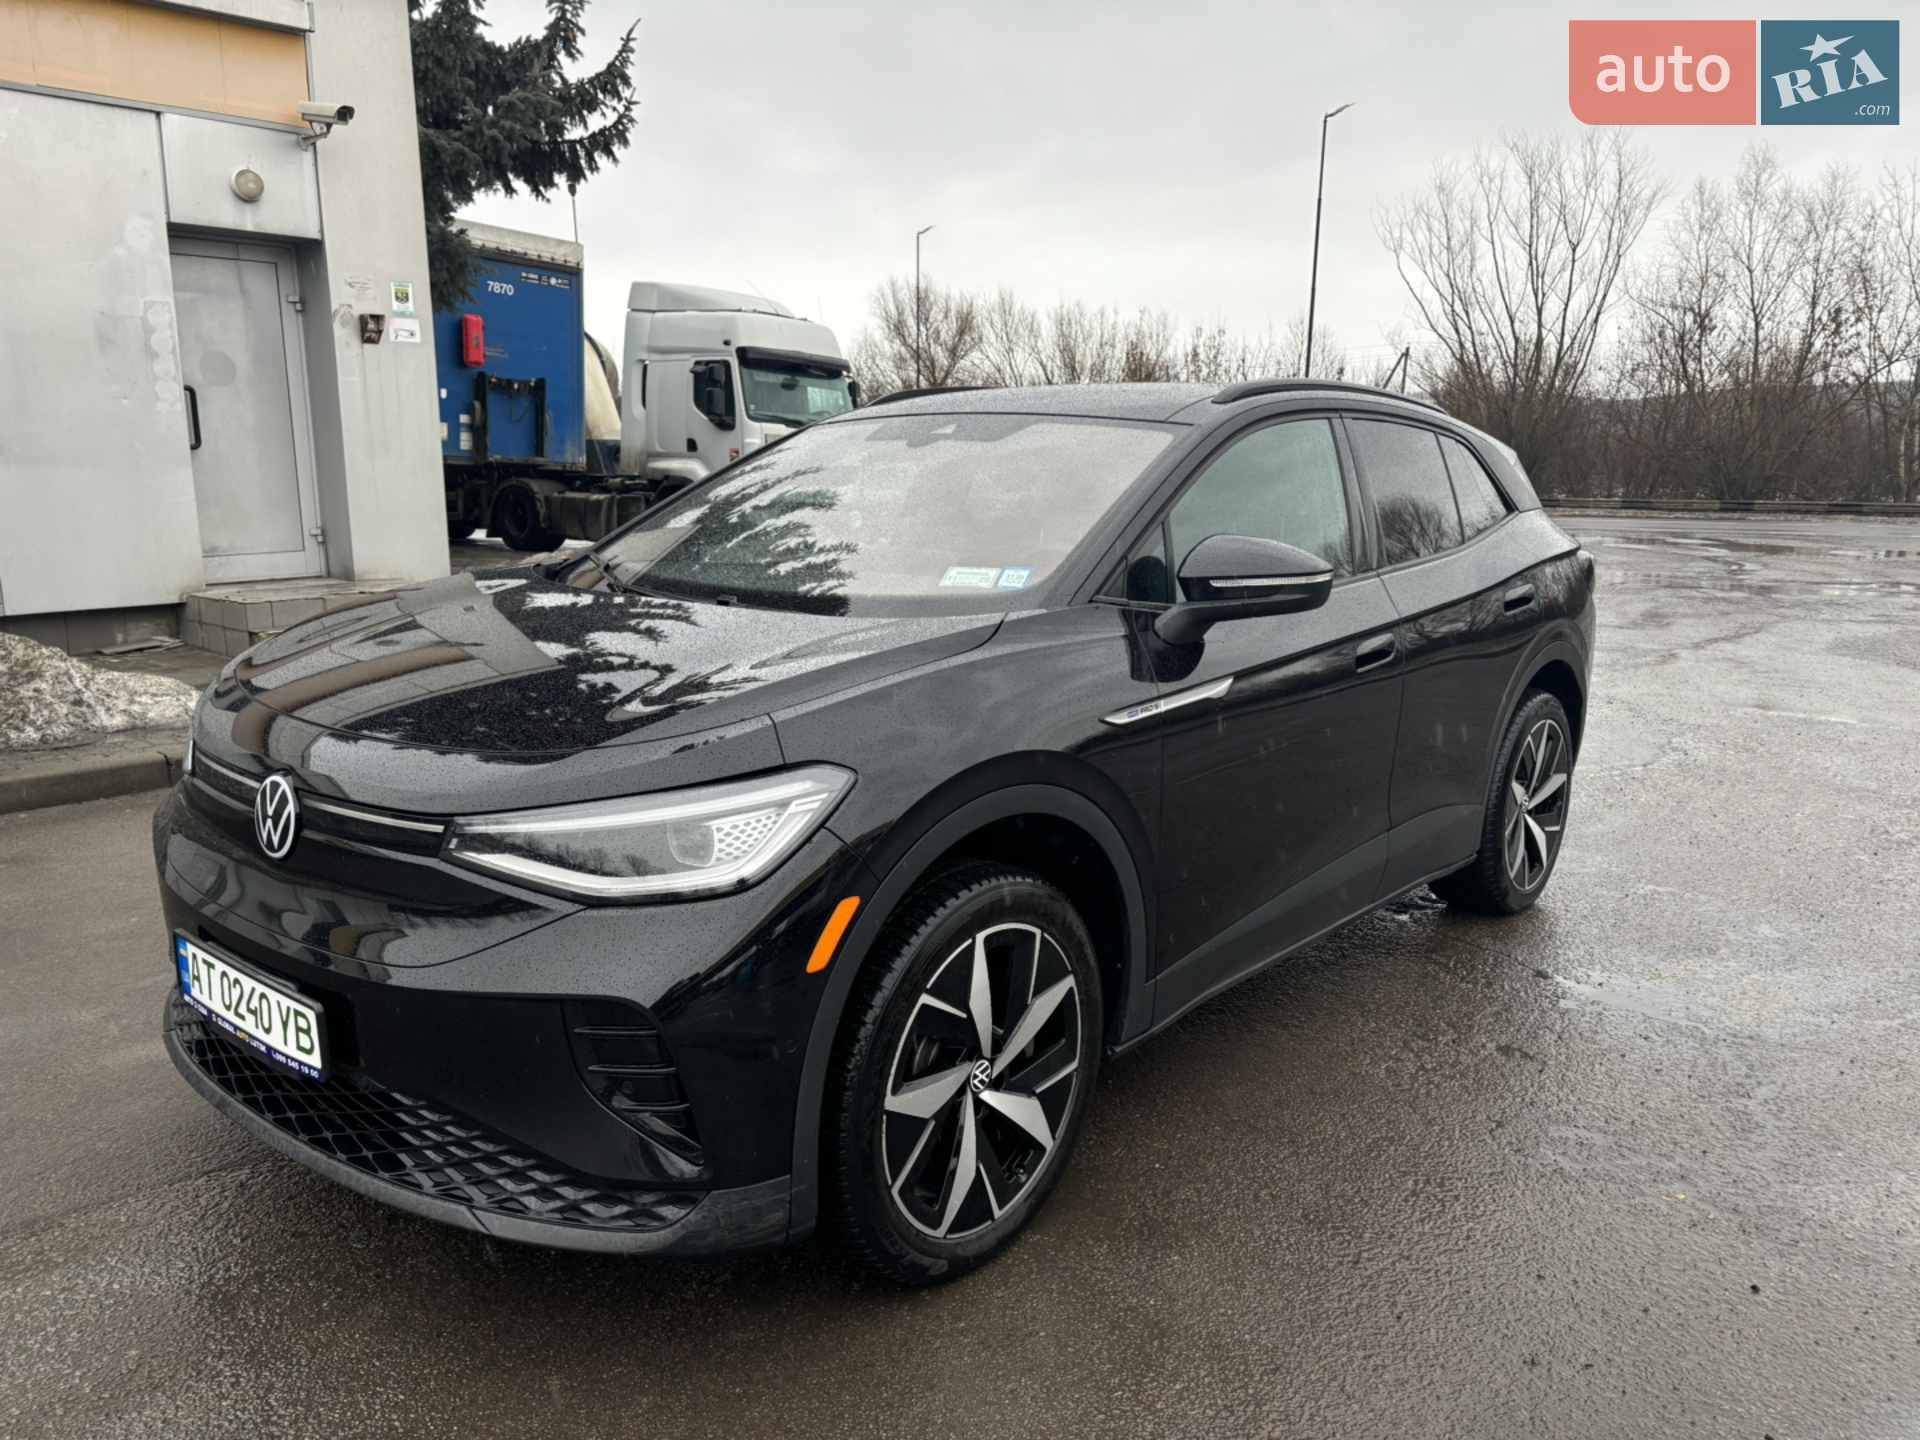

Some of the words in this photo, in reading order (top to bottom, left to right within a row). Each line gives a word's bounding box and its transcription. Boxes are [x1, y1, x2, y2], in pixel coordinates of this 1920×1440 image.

[486, 280, 515, 296] 7870
[192, 952, 215, 1001] AT
[220, 971, 272, 1035] 0240
[276, 1000, 315, 1056] YB
